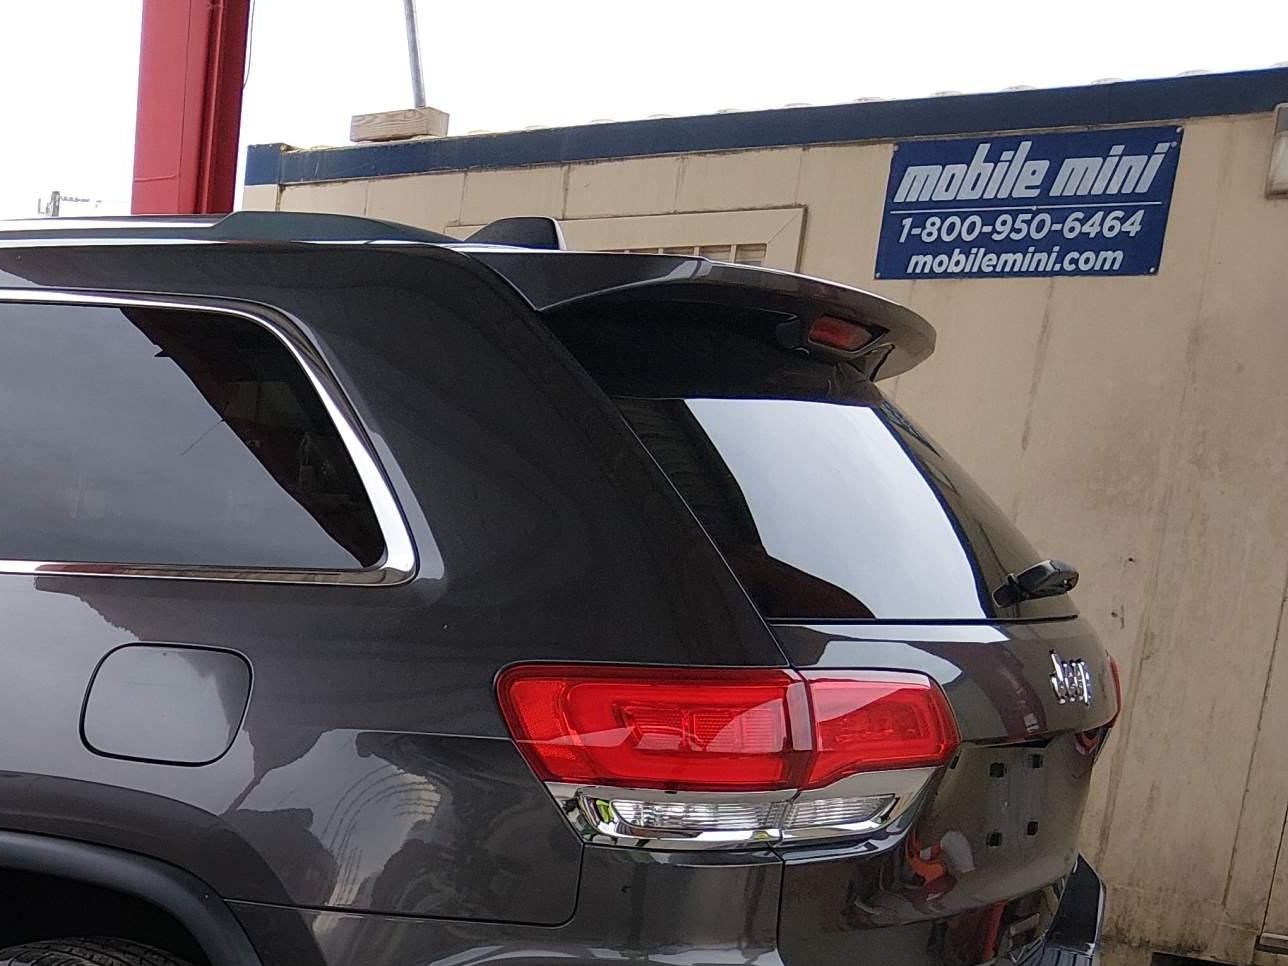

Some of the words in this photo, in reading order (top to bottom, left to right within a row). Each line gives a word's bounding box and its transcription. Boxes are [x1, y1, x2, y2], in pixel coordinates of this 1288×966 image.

[893, 141, 1050, 203] mobile
[1049, 142, 1170, 198] mini
[898, 209, 1145, 243] 1-800-950-6464
[906, 245, 1124, 274] mobilemini.com
